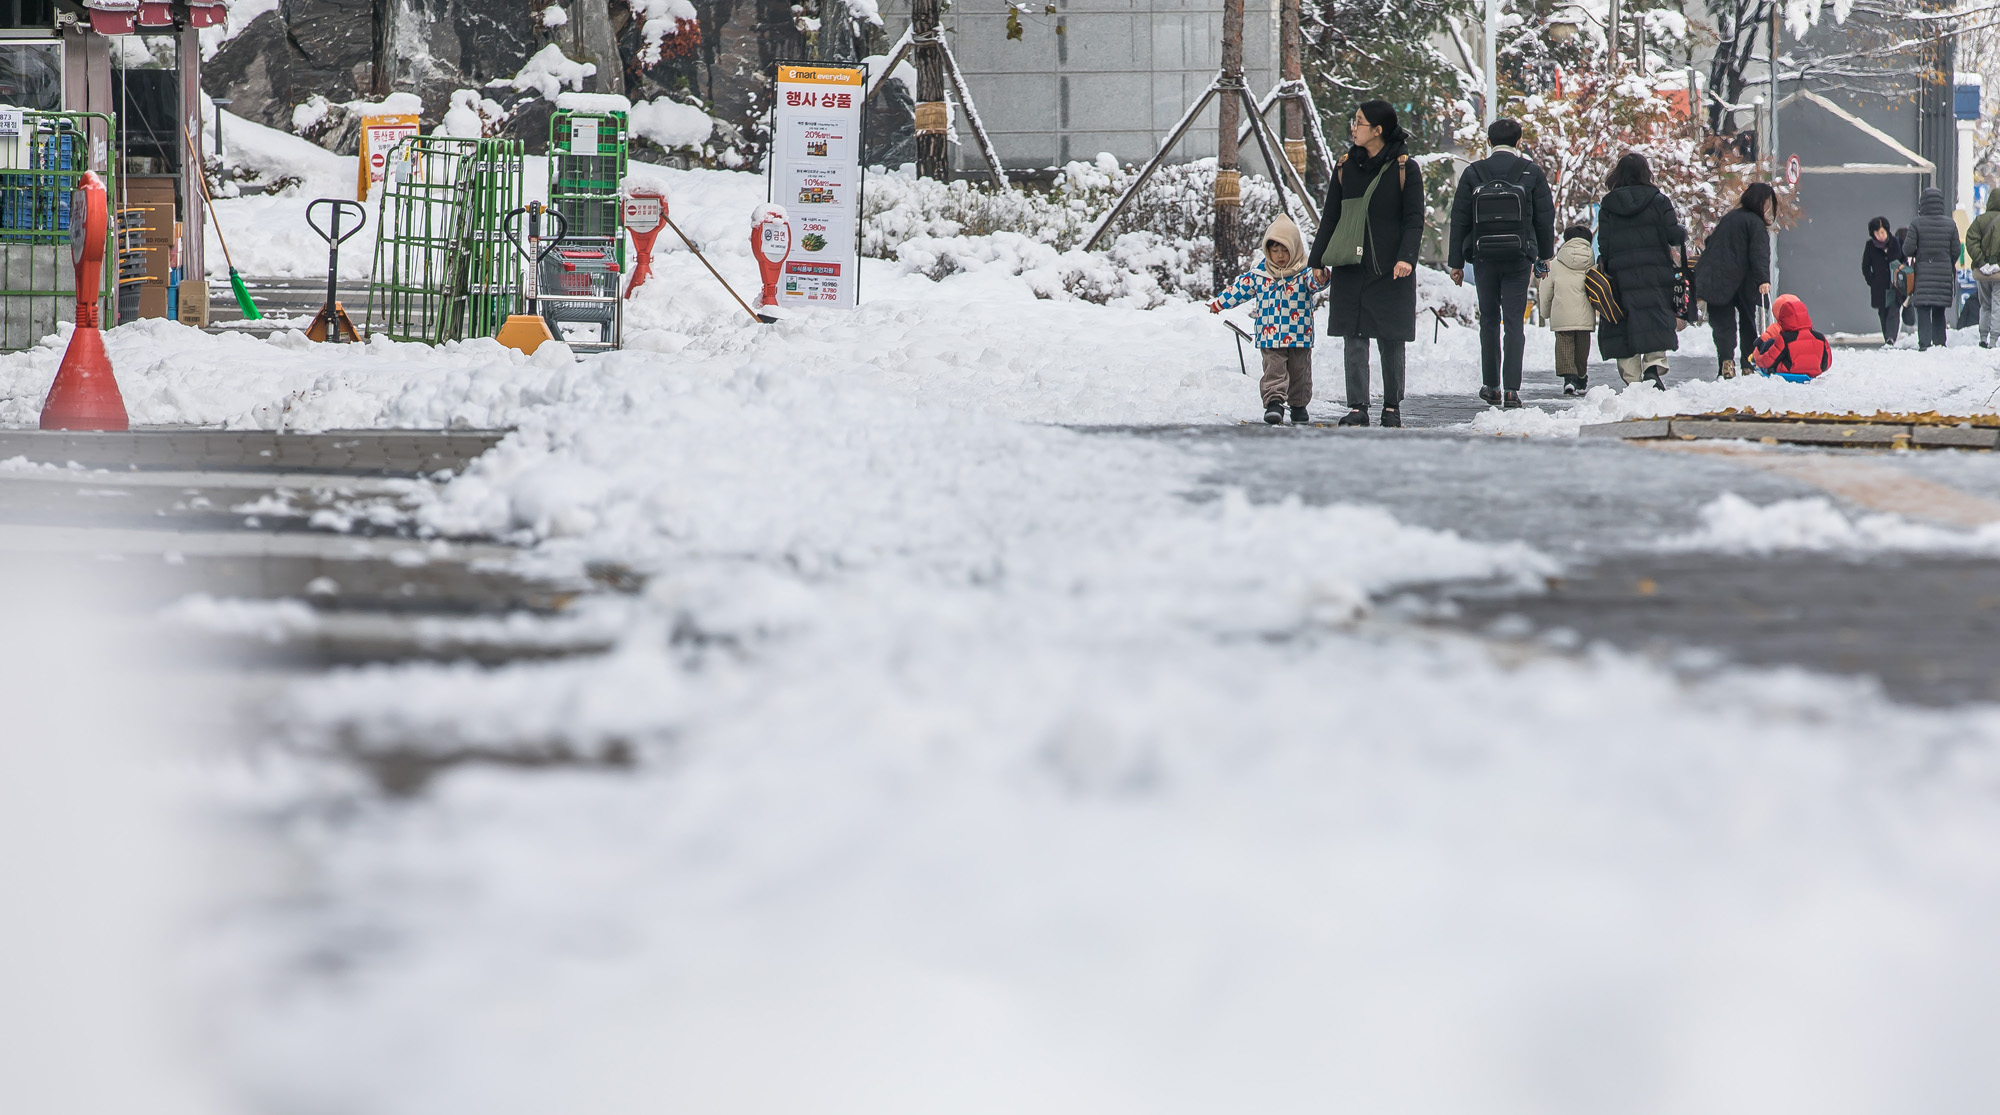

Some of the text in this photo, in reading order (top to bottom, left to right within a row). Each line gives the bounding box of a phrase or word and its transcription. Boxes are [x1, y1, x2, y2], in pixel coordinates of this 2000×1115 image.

[789, 69, 851, 82] emart everyday
[786, 91, 852, 109] 행사 상품
[374, 131, 395, 142] 등산로
[773, 230, 786, 241] 금연
